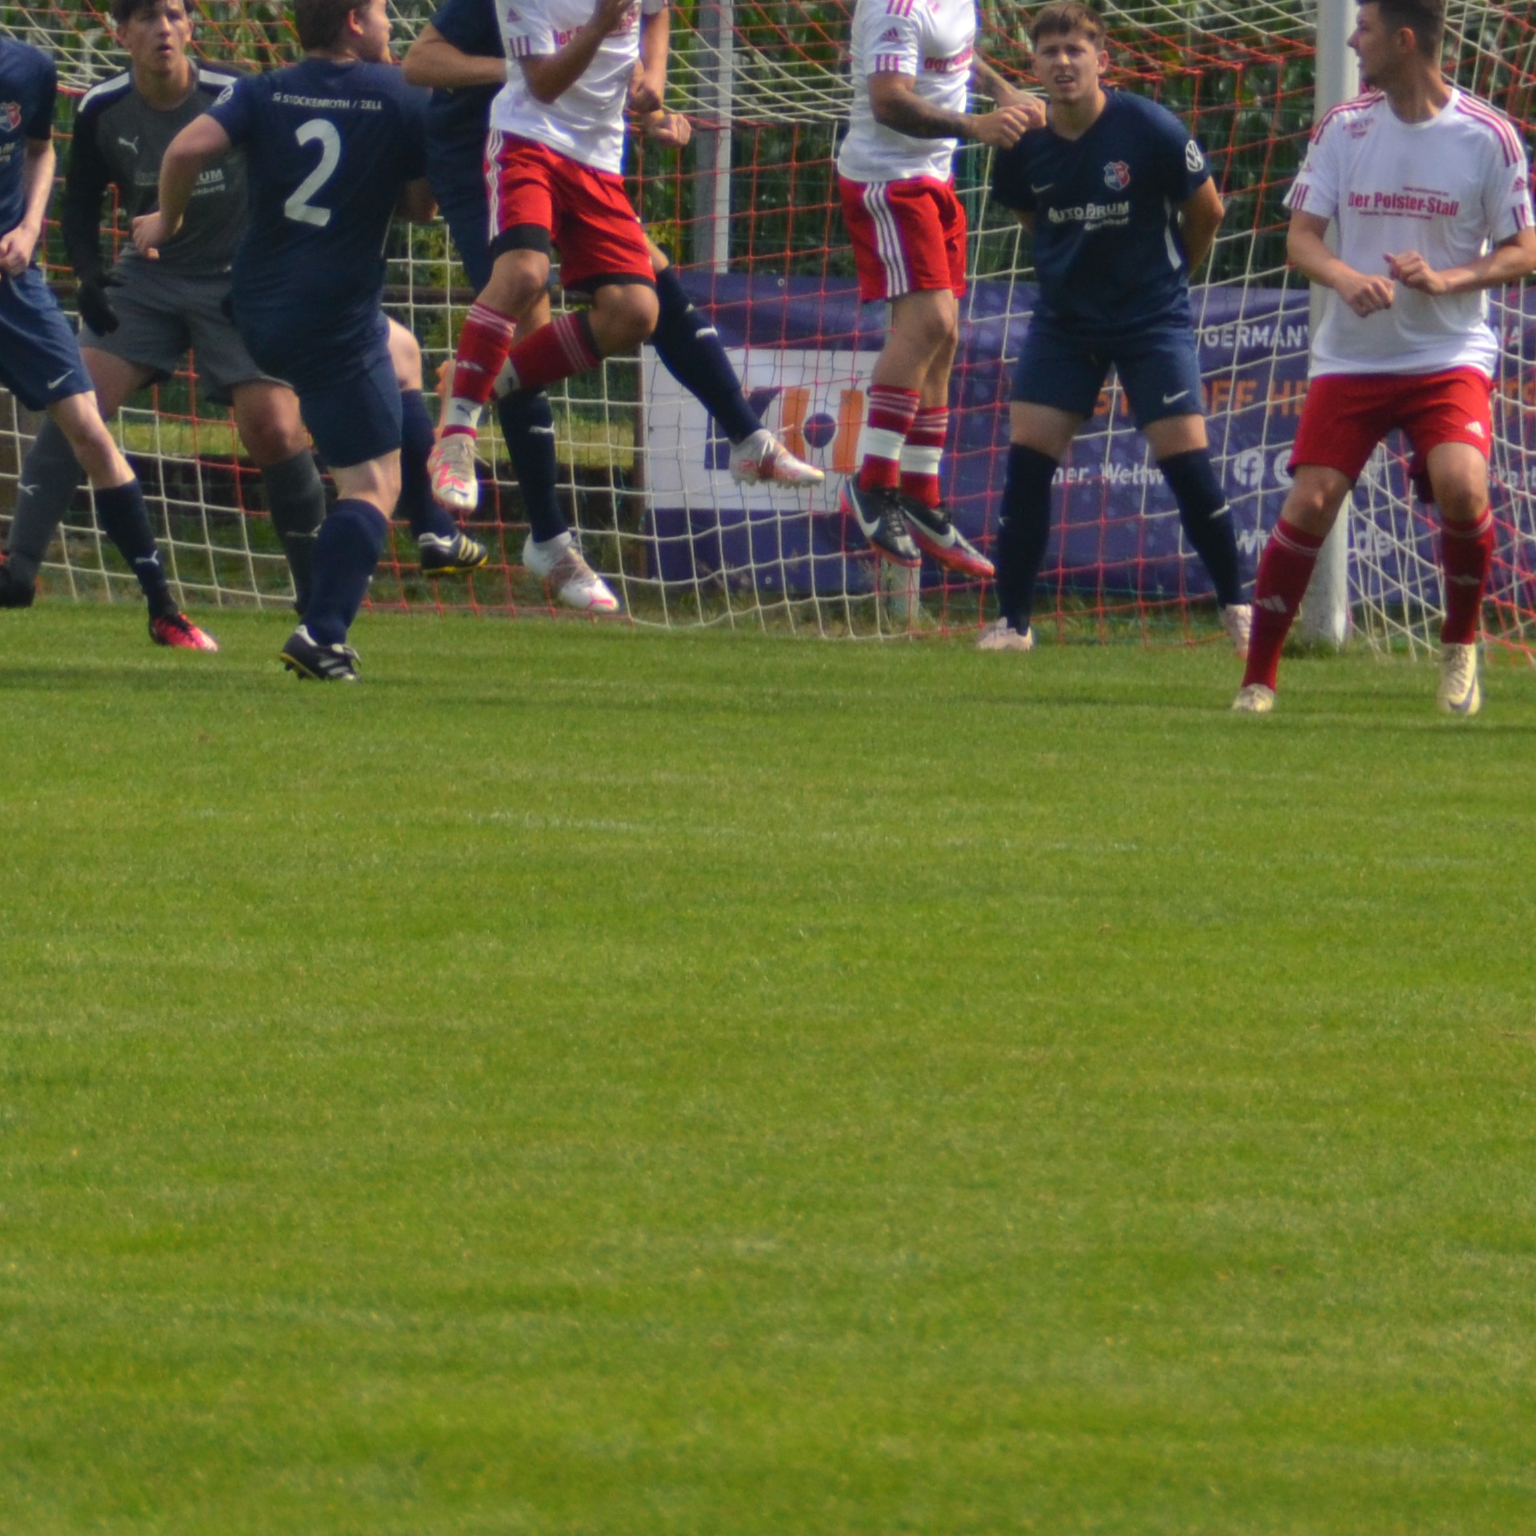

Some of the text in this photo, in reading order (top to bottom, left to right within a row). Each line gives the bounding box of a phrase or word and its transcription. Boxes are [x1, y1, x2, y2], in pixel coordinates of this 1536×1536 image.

[284, 118, 341, 227] 2
[1374, 191, 1460, 217] Polster-Stall
[1204, 323, 1309, 348] GERMAN
